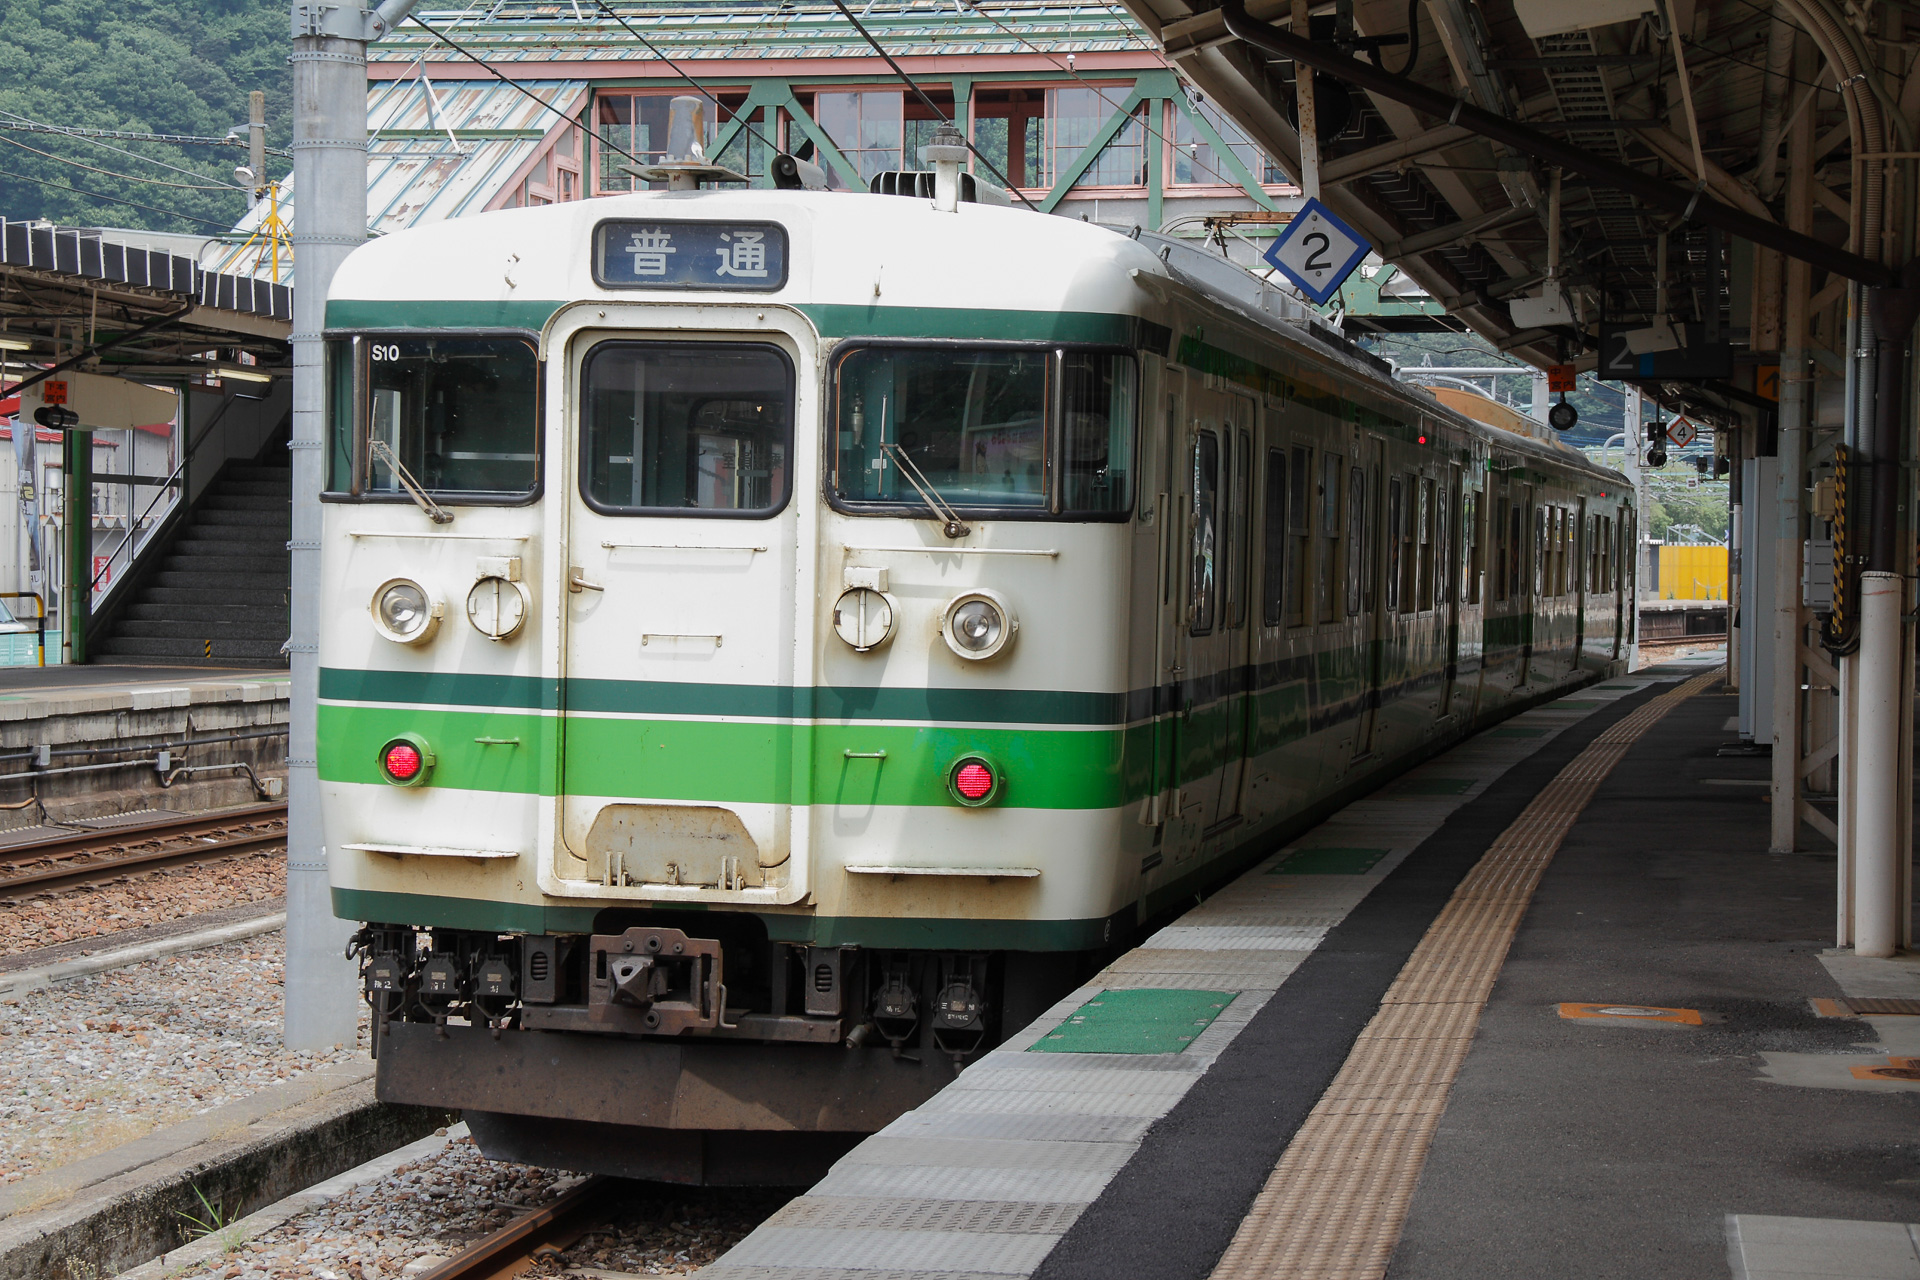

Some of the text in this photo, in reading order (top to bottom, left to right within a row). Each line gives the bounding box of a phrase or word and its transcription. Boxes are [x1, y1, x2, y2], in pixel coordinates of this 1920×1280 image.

[625, 228, 768, 277] 普通
[1302, 232, 1332, 271] 2
[371, 344, 400, 361] S10
[1608, 331, 1634, 370] 2
[1677, 426, 1687, 439] 4
